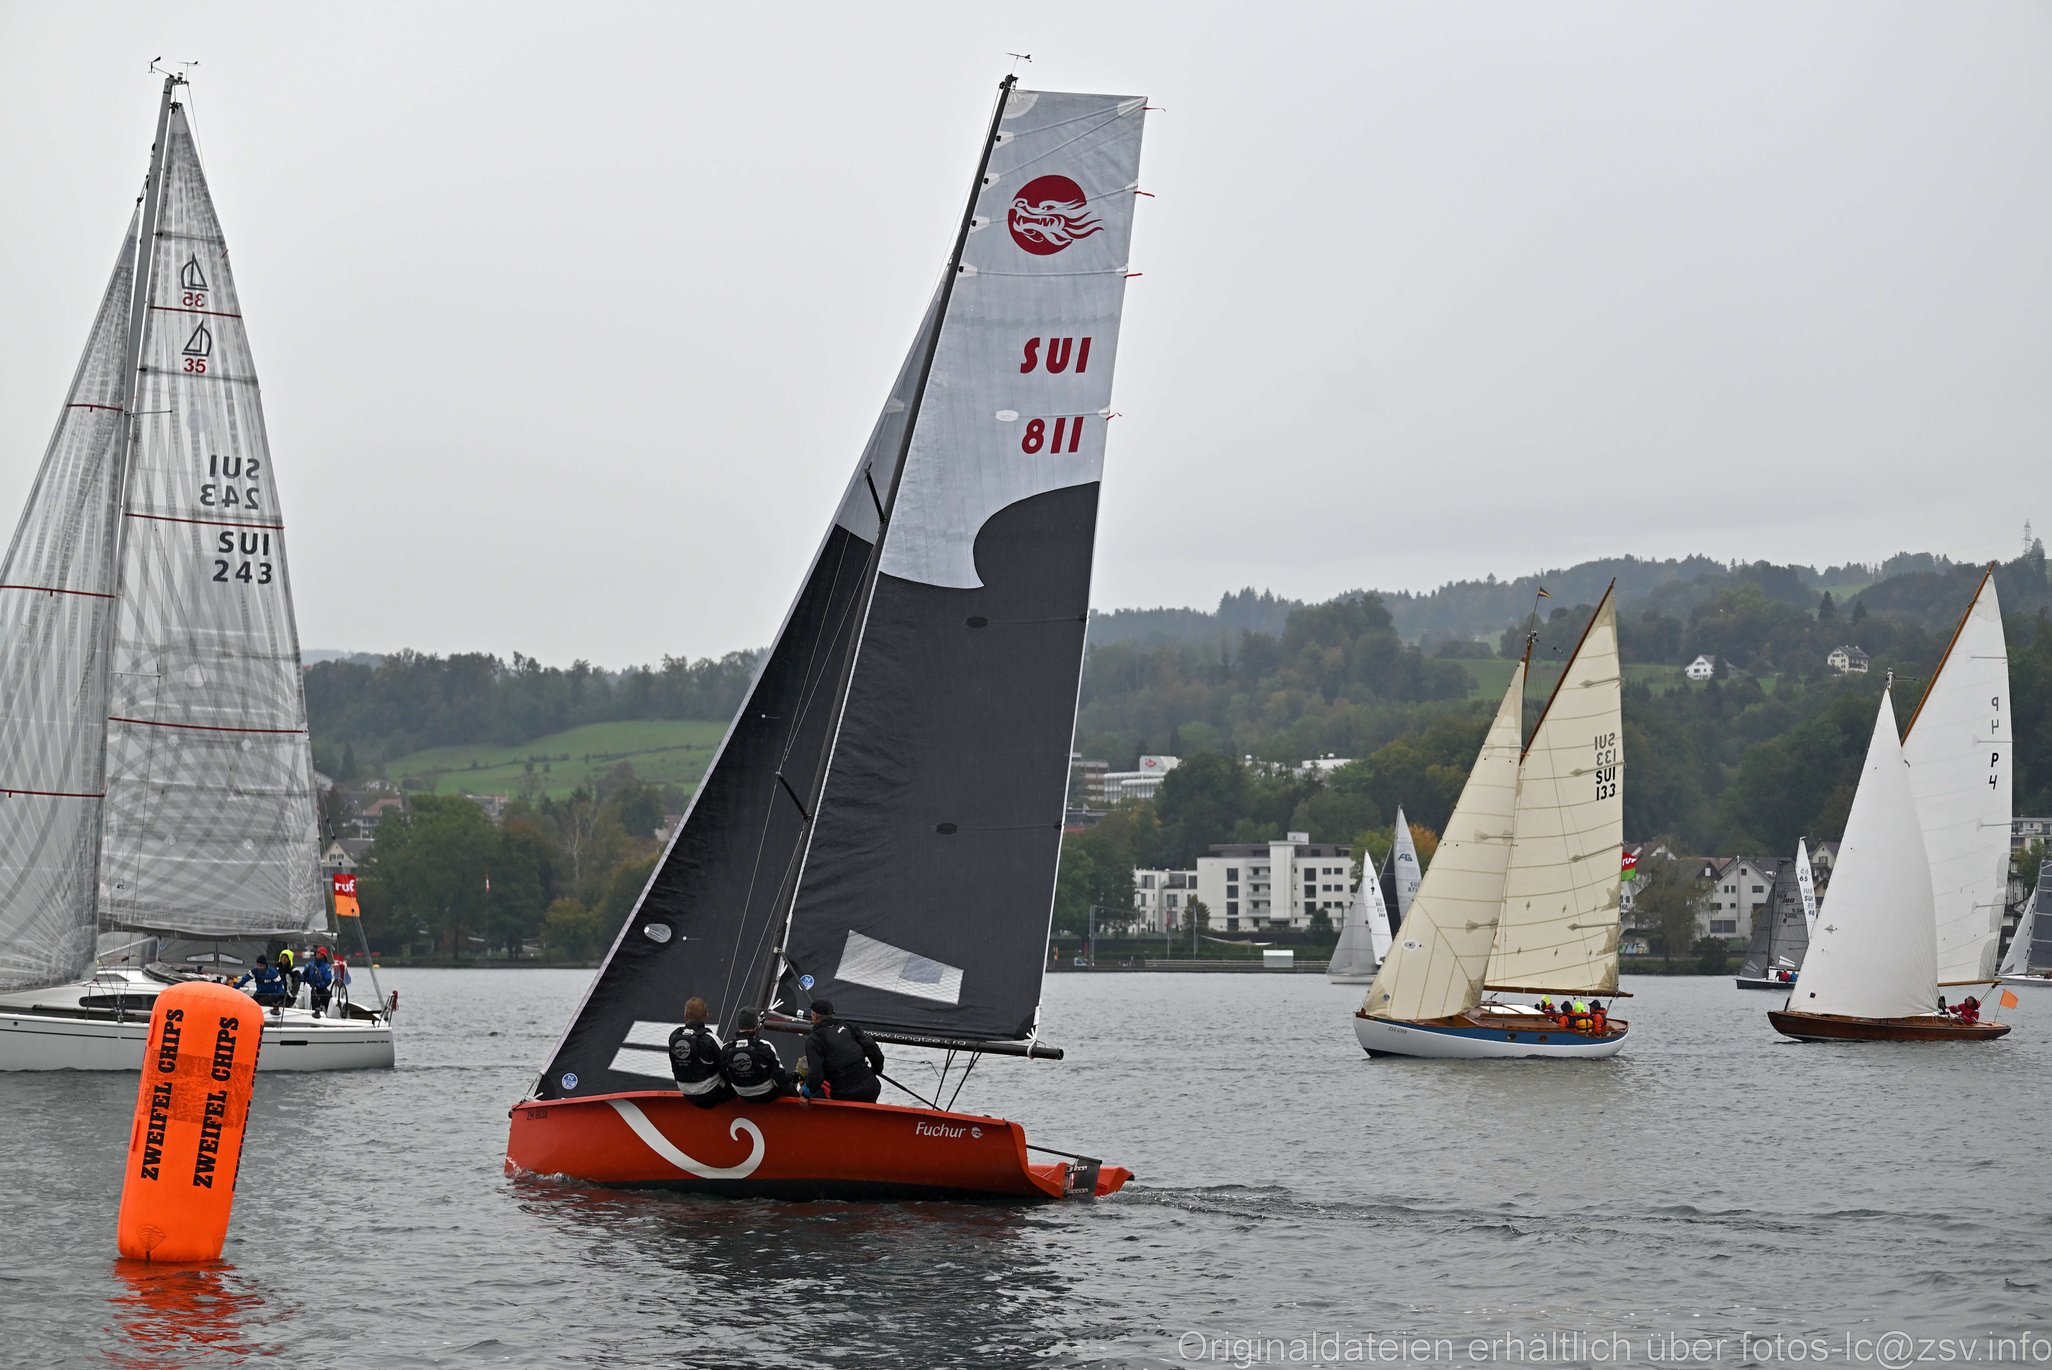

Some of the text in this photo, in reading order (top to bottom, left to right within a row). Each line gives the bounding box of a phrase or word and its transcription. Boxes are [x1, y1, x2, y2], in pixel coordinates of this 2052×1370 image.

[1020, 337, 1092, 374] SUI
[184, 358, 206, 374] 35
[1022, 416, 1084, 454] 811
[218, 531, 270, 556] SUI
[212, 560, 272, 585] 243
[1990, 752, 1999, 768] P
[1595, 766, 1616, 785] SUI
[1988, 775, 1998, 790] 4
[1596, 783, 1616, 801] 133
[335, 879, 355, 893] ruf
[140, 1009, 184, 1181] ZWEIFEL CHIPS
[192, 1016, 239, 1189] ZWEIFEL CHIPS
[915, 1121, 967, 1138] Fuchur
